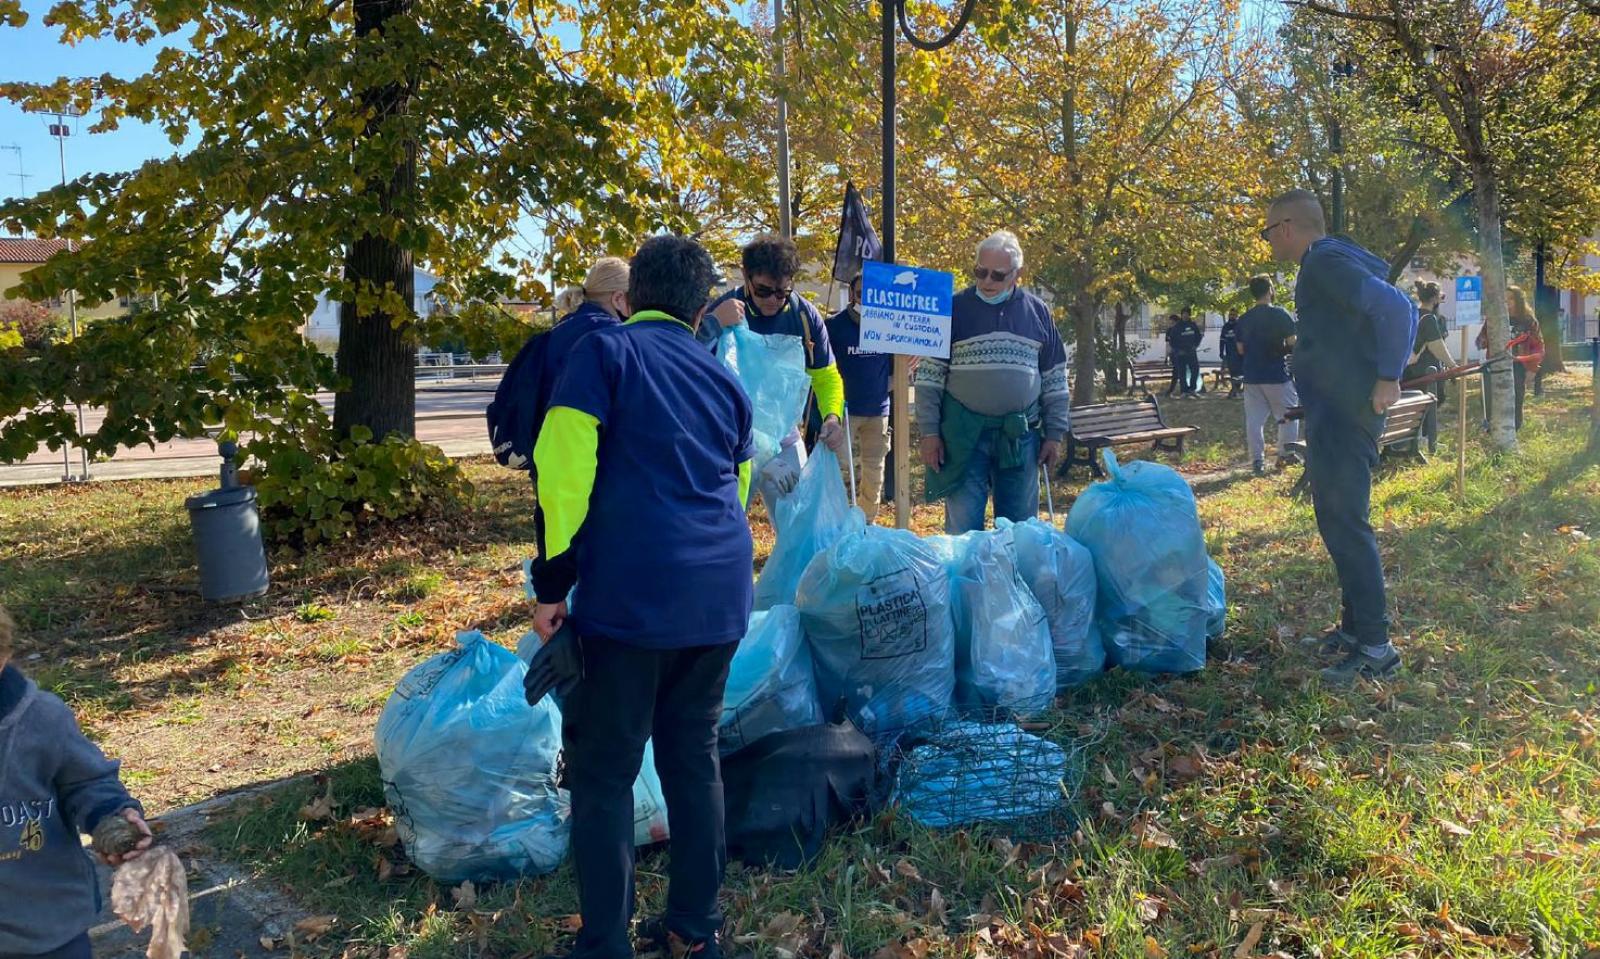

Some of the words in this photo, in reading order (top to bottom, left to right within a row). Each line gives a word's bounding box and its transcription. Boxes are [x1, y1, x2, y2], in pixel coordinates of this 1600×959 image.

[866, 287, 939, 313] PLASTICFREE
[862, 308, 895, 321] ABBIAMO
[908, 314, 931, 325] TERRA
[863, 329, 881, 341] NON
[860, 590, 918, 617] PLASTICA
